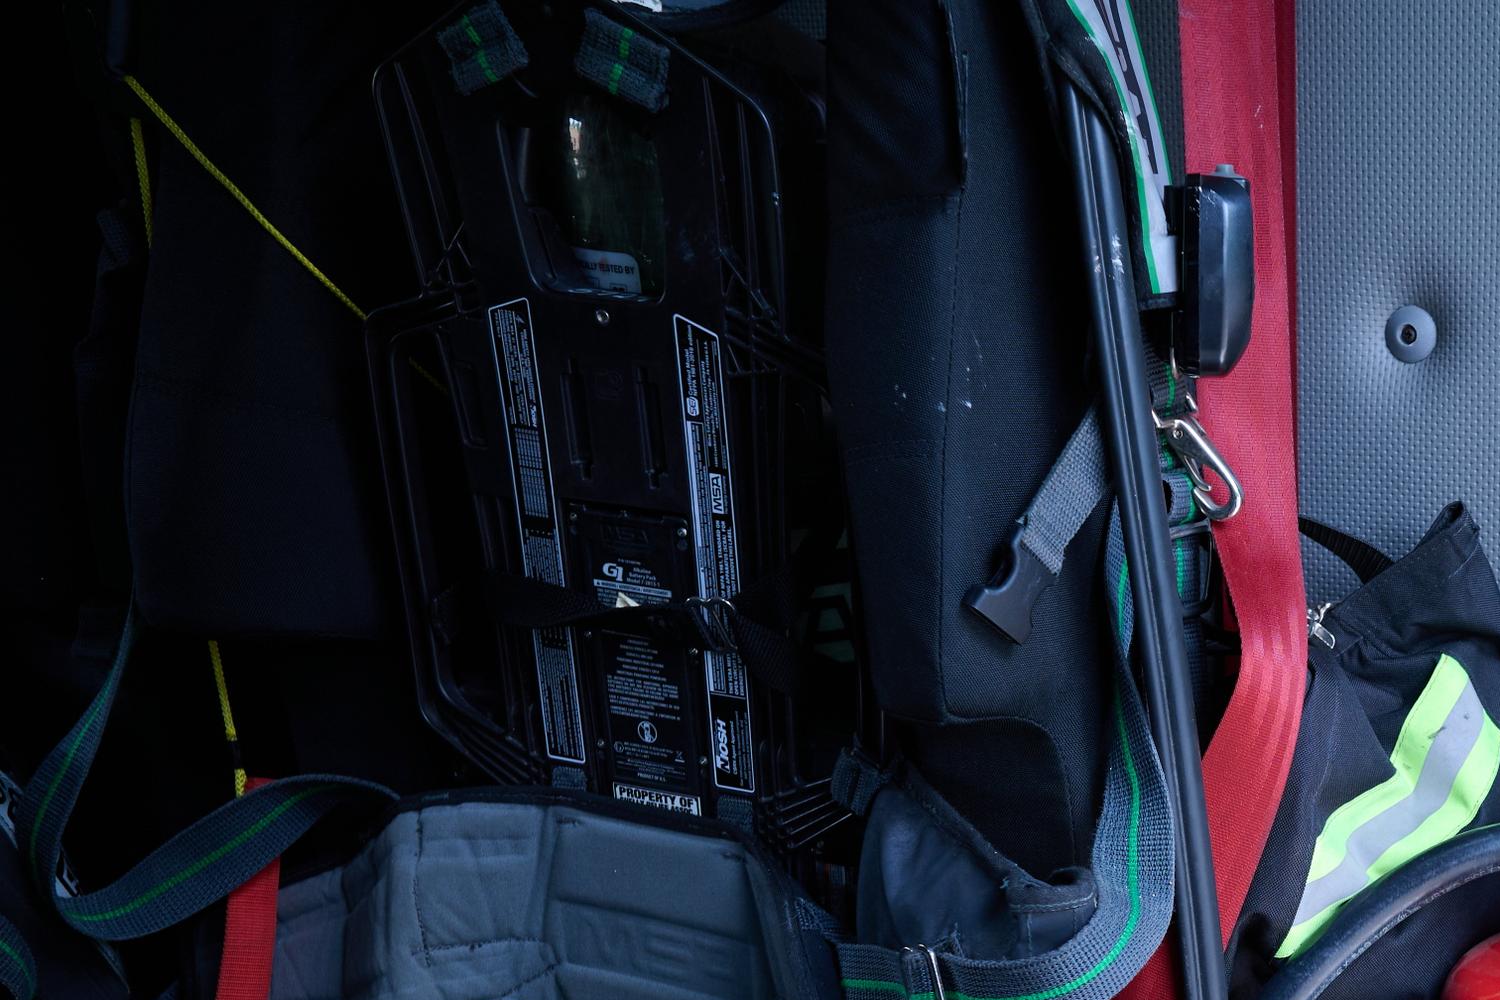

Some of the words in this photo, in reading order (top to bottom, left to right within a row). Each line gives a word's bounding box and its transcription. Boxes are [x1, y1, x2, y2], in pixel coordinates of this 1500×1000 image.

[712, 475, 722, 512] MSA
[602, 562, 624, 582] G1
[712, 717, 730, 773] NIOSH
[619, 787, 676, 805] PROPERTY
[679, 797, 693, 808] OF
